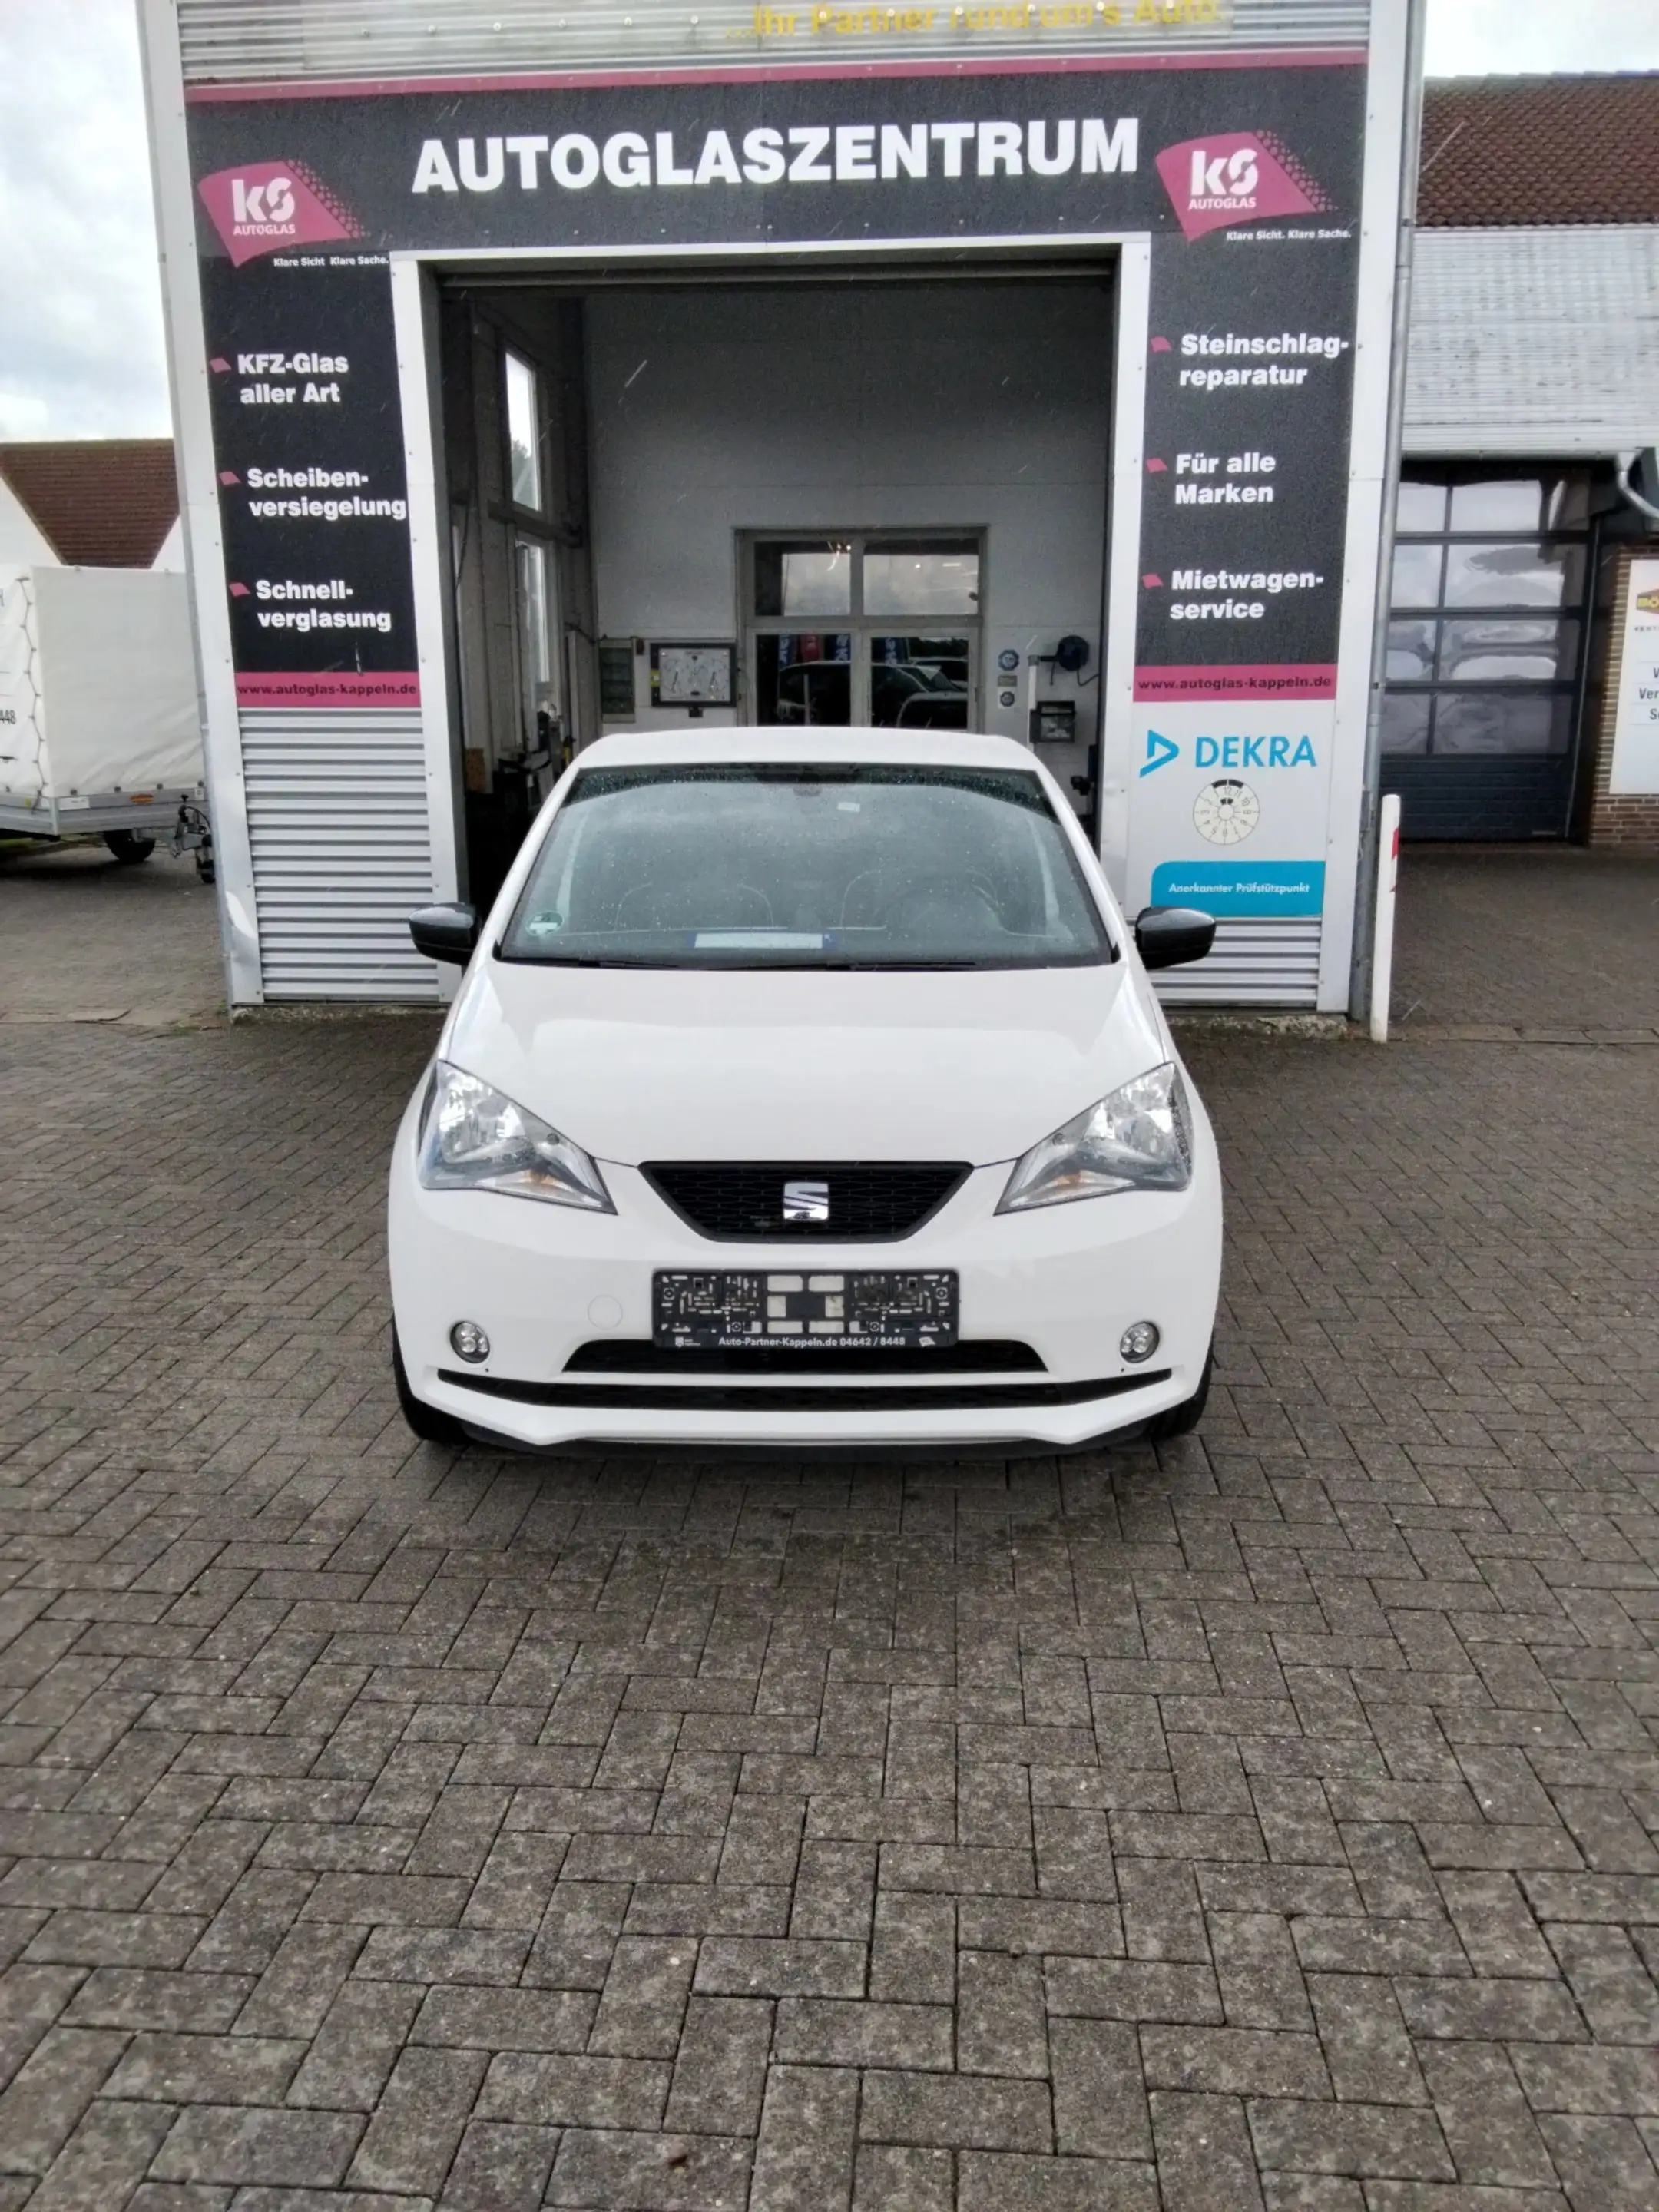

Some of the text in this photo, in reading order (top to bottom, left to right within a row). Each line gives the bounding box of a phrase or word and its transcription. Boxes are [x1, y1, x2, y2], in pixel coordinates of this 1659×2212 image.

[810, 3, 939, 34] Partner
[949, 2, 1031, 30] rund
[411, 118, 1139, 194] AUTOGLASZENTRUM
[1188, 197, 1257, 210] AUTOGLAS
[233, 224, 296, 236] AUTOGLAS
[1227, 228, 1352, 240] Klare Sicht. Klare Sache.
[273, 258, 299, 267] Klare
[330, 257, 356, 266] Klare
[358, 255, 389, 265] Sache.
[1181, 333, 1349, 359] Steinschlag-
[237, 353, 349, 375] KFZ-Glas
[1180, 367, 1308, 390] reparatur
[240, 382, 341, 405] aller Art
[1175, 452, 1276, 475] Für alle
[247, 468, 369, 489] Scheiben-
[1174, 483, 1274, 505] Marken
[248, 497, 407, 521] versiegelung
[255, 580, 354, 601] Schnell-
[1171, 570, 1324, 593] Mietwagen-
[257, 610, 392, 632] verglasung
[1169, 600, 1265, 621] service
[237, 682, 417, 697] www.autoglas-kappeln.de
[1137, 677, 1332, 690] www.autoglas-kappeln.de
[1194, 735, 1317, 768] DEKRA
[1168, 882, 1310, 895] Anerkannter Prüfstützpunkt
[718, 1336, 838, 1349] Auto-Partner-Kappeln.de
[839, 1336, 871, 1347] 04642
